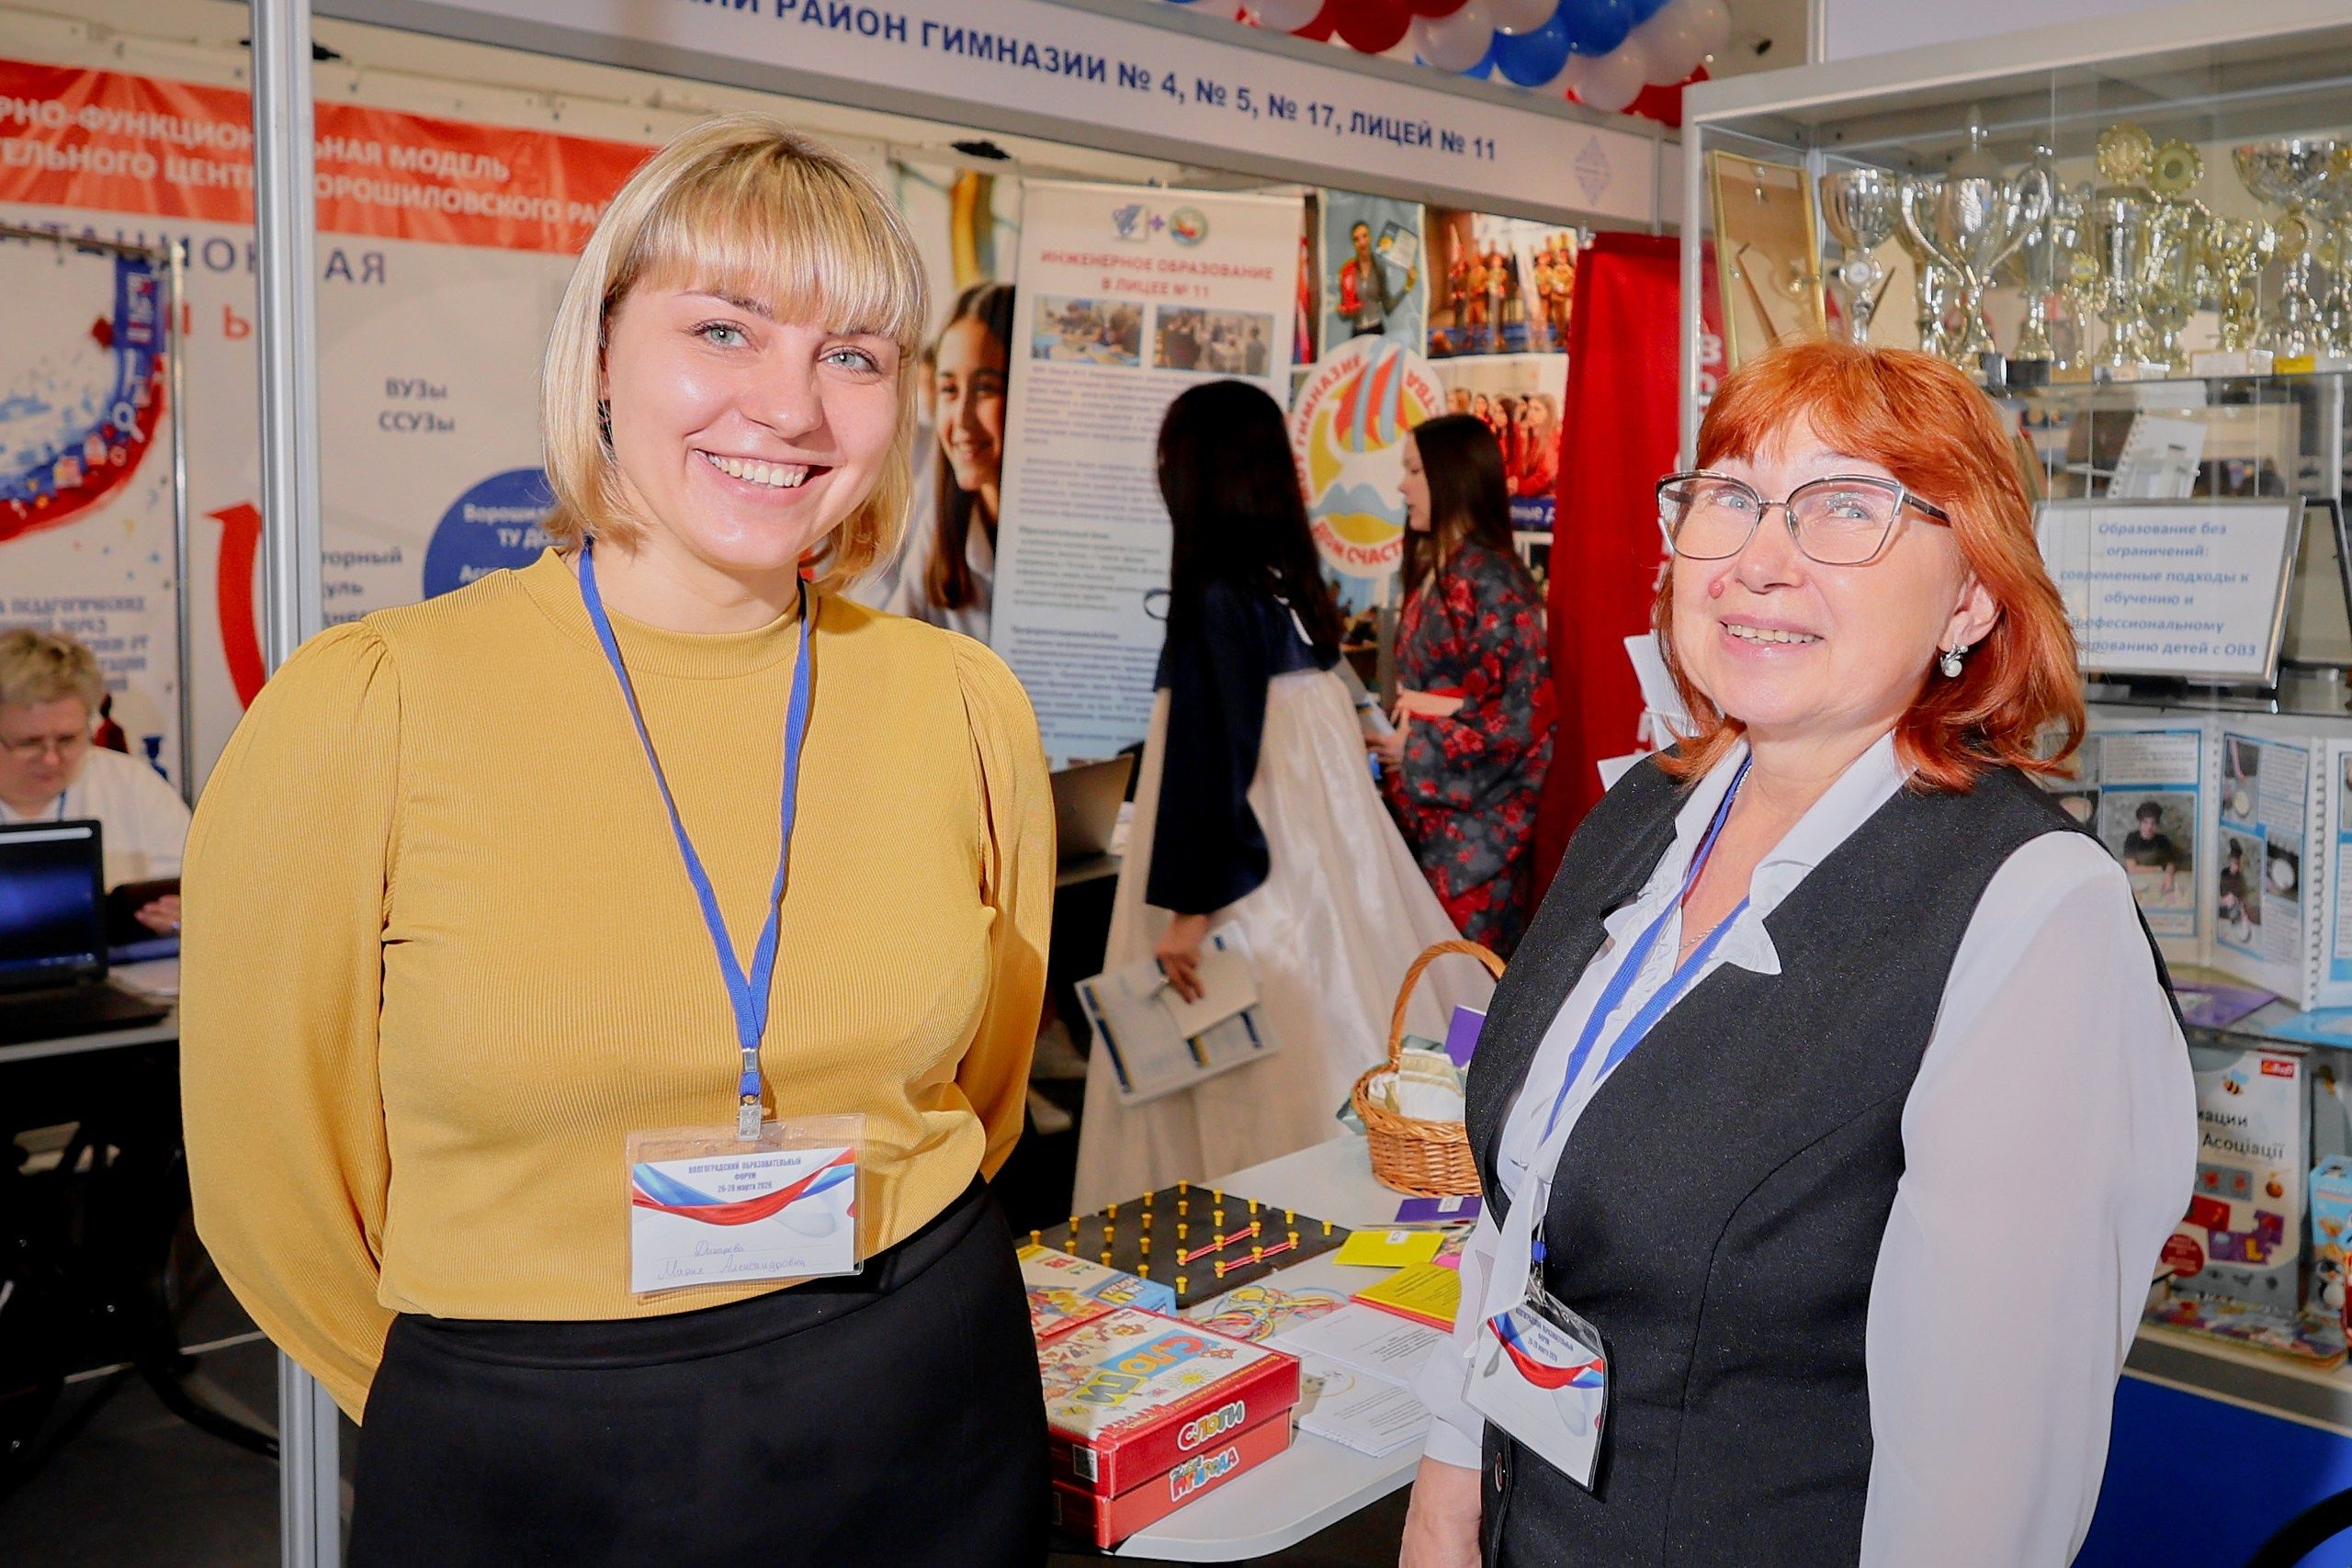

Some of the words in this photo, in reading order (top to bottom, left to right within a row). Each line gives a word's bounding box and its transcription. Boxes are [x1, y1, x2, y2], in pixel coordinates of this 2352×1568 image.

[921, 20, 1106, 84] ГИМНАЗИИ
[1118, 61, 1151, 91] №
[1161, 71, 1184, 104] 4,
[1195, 78, 1227, 107] №
[1237, 86, 1259, 119] 5,
[1268, 93, 1297, 121] №
[1306, 101, 1341, 135] 17,
[1349, 109, 1432, 148] ЛИЦЕЙ
[1440, 130, 1465, 154] №
[1474, 138, 1496, 160] 11
[390, 145, 511, 182] МОДЕЛЬ
[314, 172, 561, 223] ОРОШИЛОВСКОГО
[1041, 250, 1152, 271] ИНЖЕНЕРНОЕ
[1158, 258, 1274, 280] ОБРАЗОВАНИЕ
[1102, 276, 1111, 290] В
[1115, 277, 1169, 296] ЛИЦЕЕ
[1194, 284, 1210, 298] 11
[386, 378, 447, 399] ВУЗы
[378, 412, 456, 433] ССУЗы
[2098, 522, 2197, 537] Образование
[2201, 521, 2227, 536] без
[2060, 570, 2162, 582] современные
[2166, 571, 2235, 584] подходы
[2240, 573, 2249, 582] к
[2104, 592, 2180, 606] обучению
[2185, 596, 2194, 605] и
[2163, 642, 2208, 655] детей
[2212, 646, 2220, 656] с
[2224, 643, 2256, 657] ОВЗ
[688, 1161, 740, 1174] ВОЛГОГРАДСКИЙ
[741, 1156, 802, 1169] ОБРАЗОВАТЕЛЬНЫЙ
[734, 1171, 756, 1180] ФОРУМ
[1178, 1400, 1245, 1450] СЛОГИ
